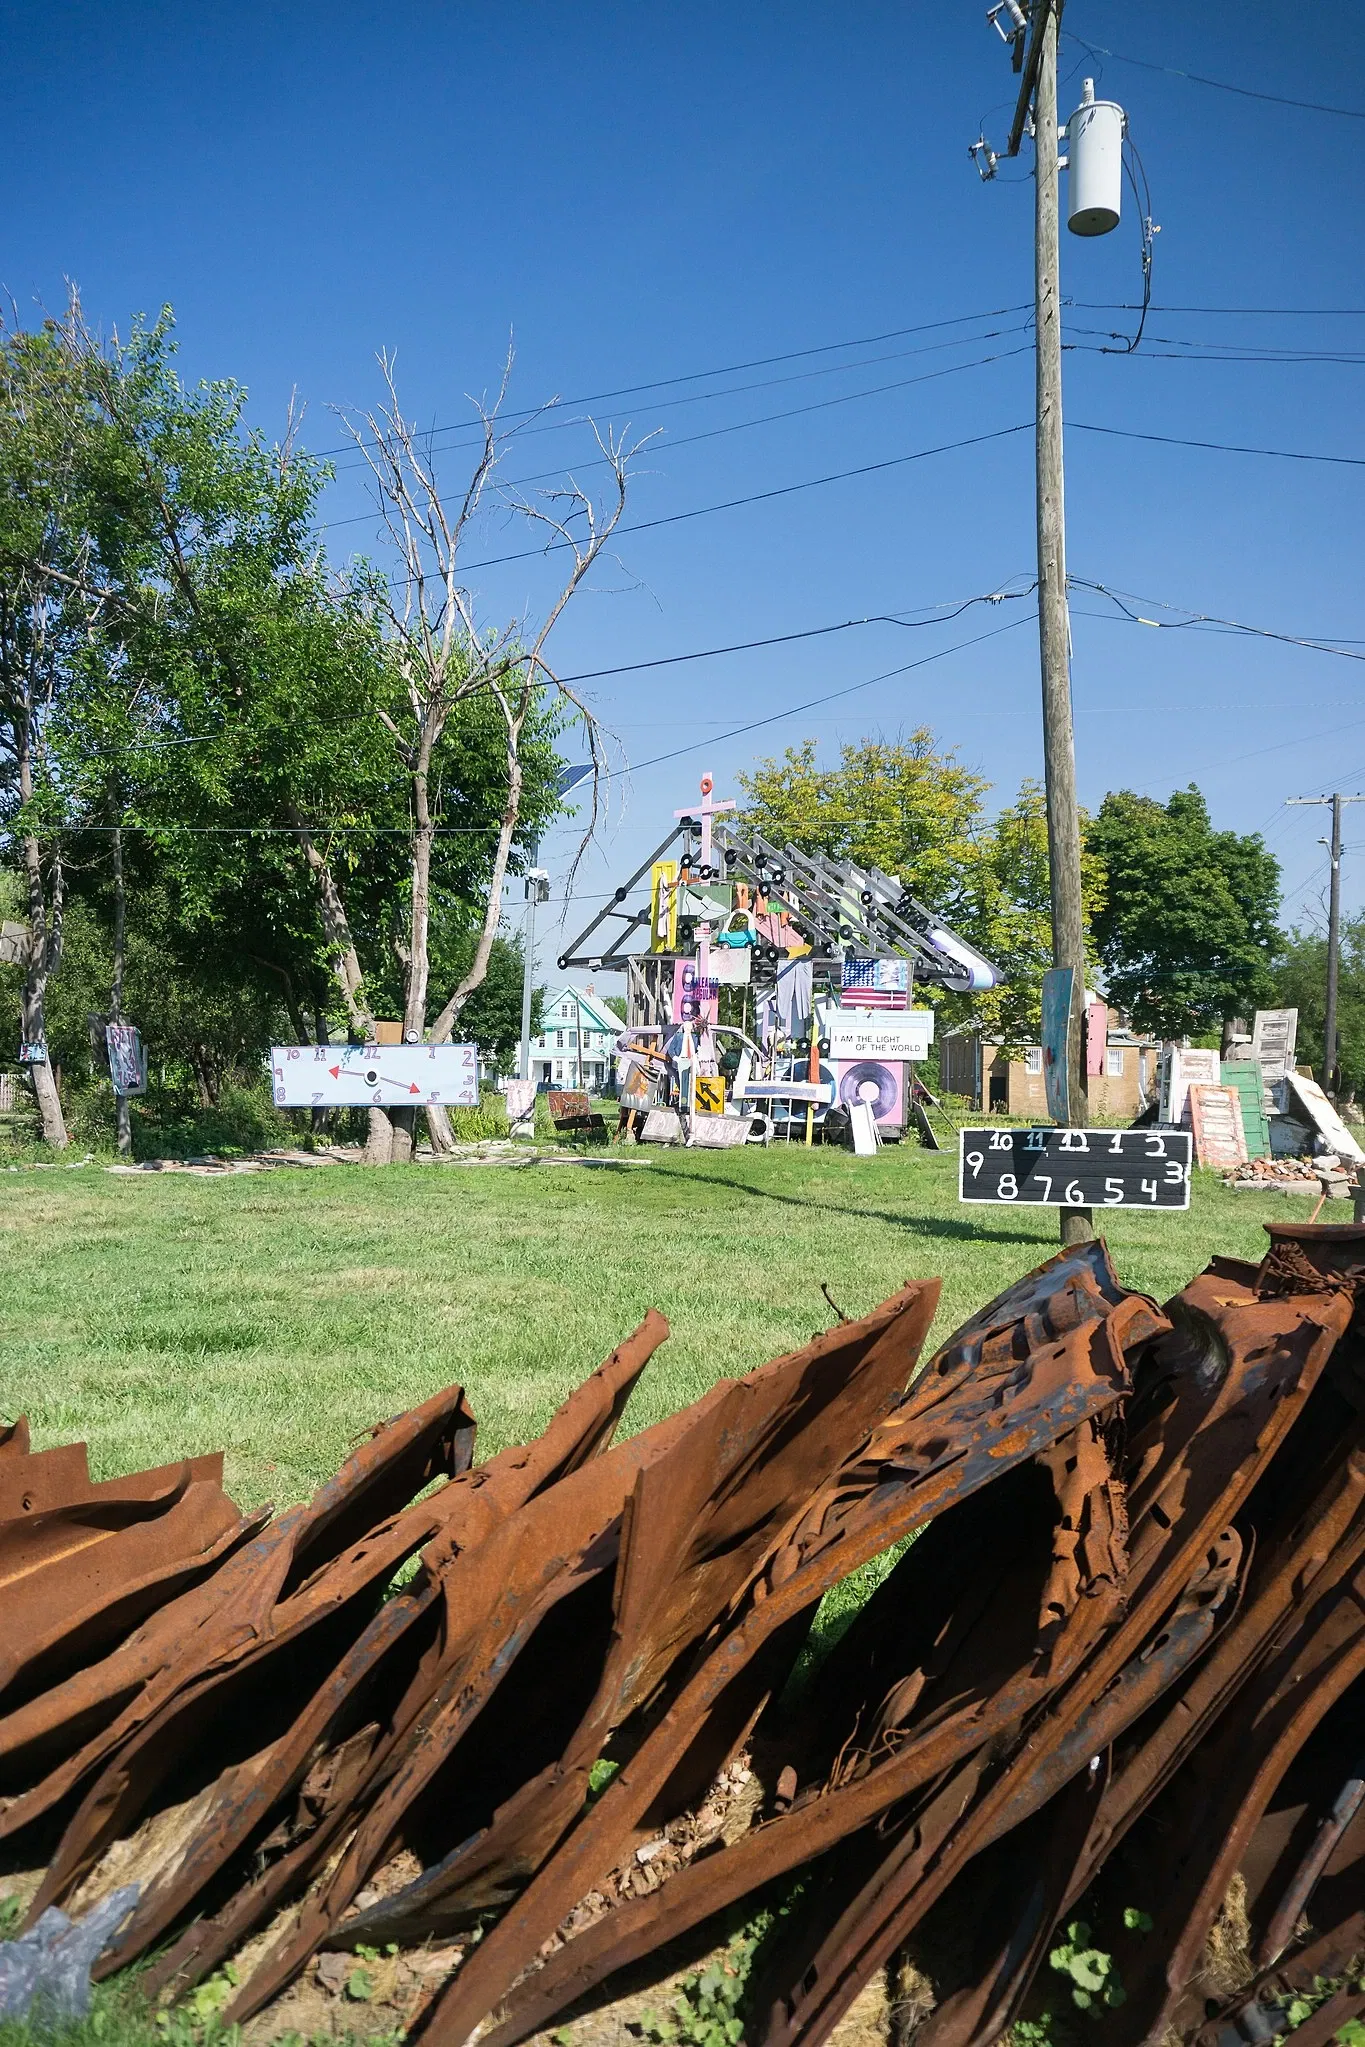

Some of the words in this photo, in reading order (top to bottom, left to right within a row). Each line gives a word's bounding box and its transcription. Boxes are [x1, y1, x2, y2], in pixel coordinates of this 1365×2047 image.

[856, 1035, 872, 1043] THE
[876, 1035, 900, 1043] LIGHT
[286, 1049, 300, 1061] 10
[314, 1048, 326, 1061] 11
[364, 1047, 380, 1060] 12
[428, 1047, 436, 1059] 1
[462, 1051, 474, 1067] 2
[275, 1068, 284, 1082] 9
[463, 1075, 474, 1085] 3
[276, 1087, 286, 1102] 8
[312, 1093, 324, 1104] 7
[373, 1089, 382, 1103] 6
[427, 1091, 440, 1102] 5
[459, 1090, 474, 1103] 4
[988, 1132, 1014, 1151] 10
[1023, 1132, 1046, 1151] 11
[1058, 1132, 1090, 1153] 12
[1108, 1133, 1124, 1154] 1
[1145, 1134, 1167, 1157] 2
[966, 1151, 985, 1179] 9
[1163, 1161, 1184, 1184] 3
[997, 1173, 1019, 1199] 8
[1033, 1175, 1053, 1202] 7
[1065, 1179, 1084, 1203] 6
[1103, 1178, 1125, 1204] 5
[1141, 1179, 1158, 1202] 4
